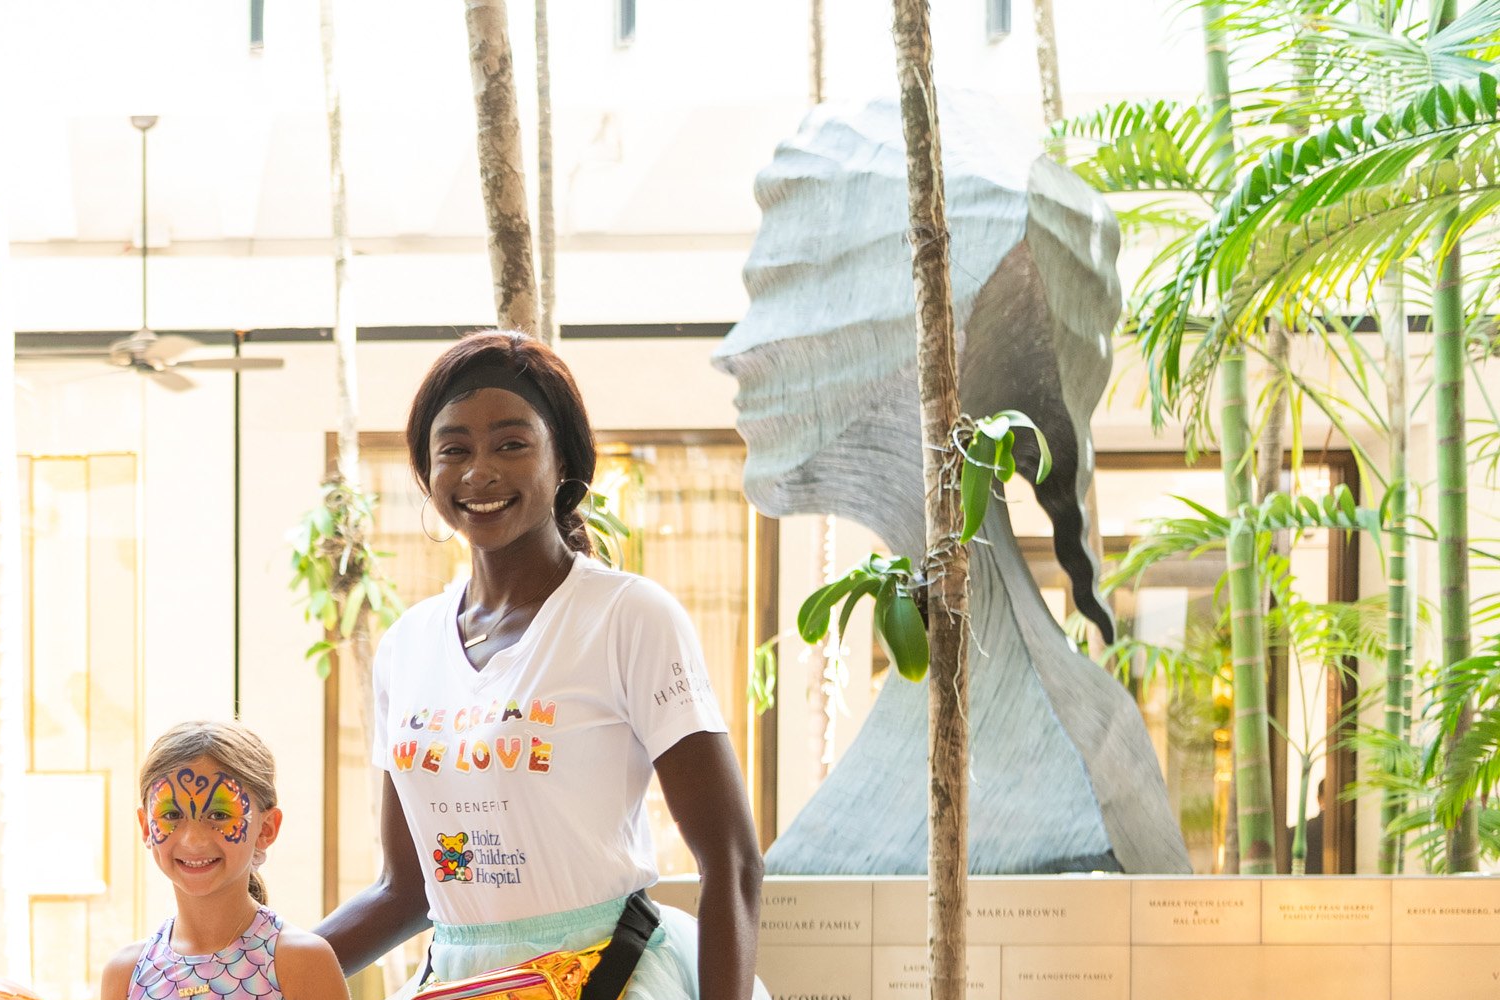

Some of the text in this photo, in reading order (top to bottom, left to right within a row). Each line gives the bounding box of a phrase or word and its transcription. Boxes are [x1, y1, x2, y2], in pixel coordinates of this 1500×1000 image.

[401, 700, 557, 732] ICE CREAM
[393, 737, 553, 774] WE LOVE
[430, 800, 509, 813] TO BENEFIT
[471, 830, 501, 847] Holtz
[474, 849, 526, 866] Children's
[475, 867, 521, 888] Hospital
[760, 896, 797, 906] ALOPPI
[977, 908, 1015, 918] MARIA
[1018, 908, 1067, 918] BROWNE
[820, 921, 861, 930] FAMILY
[1083, 971, 1113, 980] FAMILY
